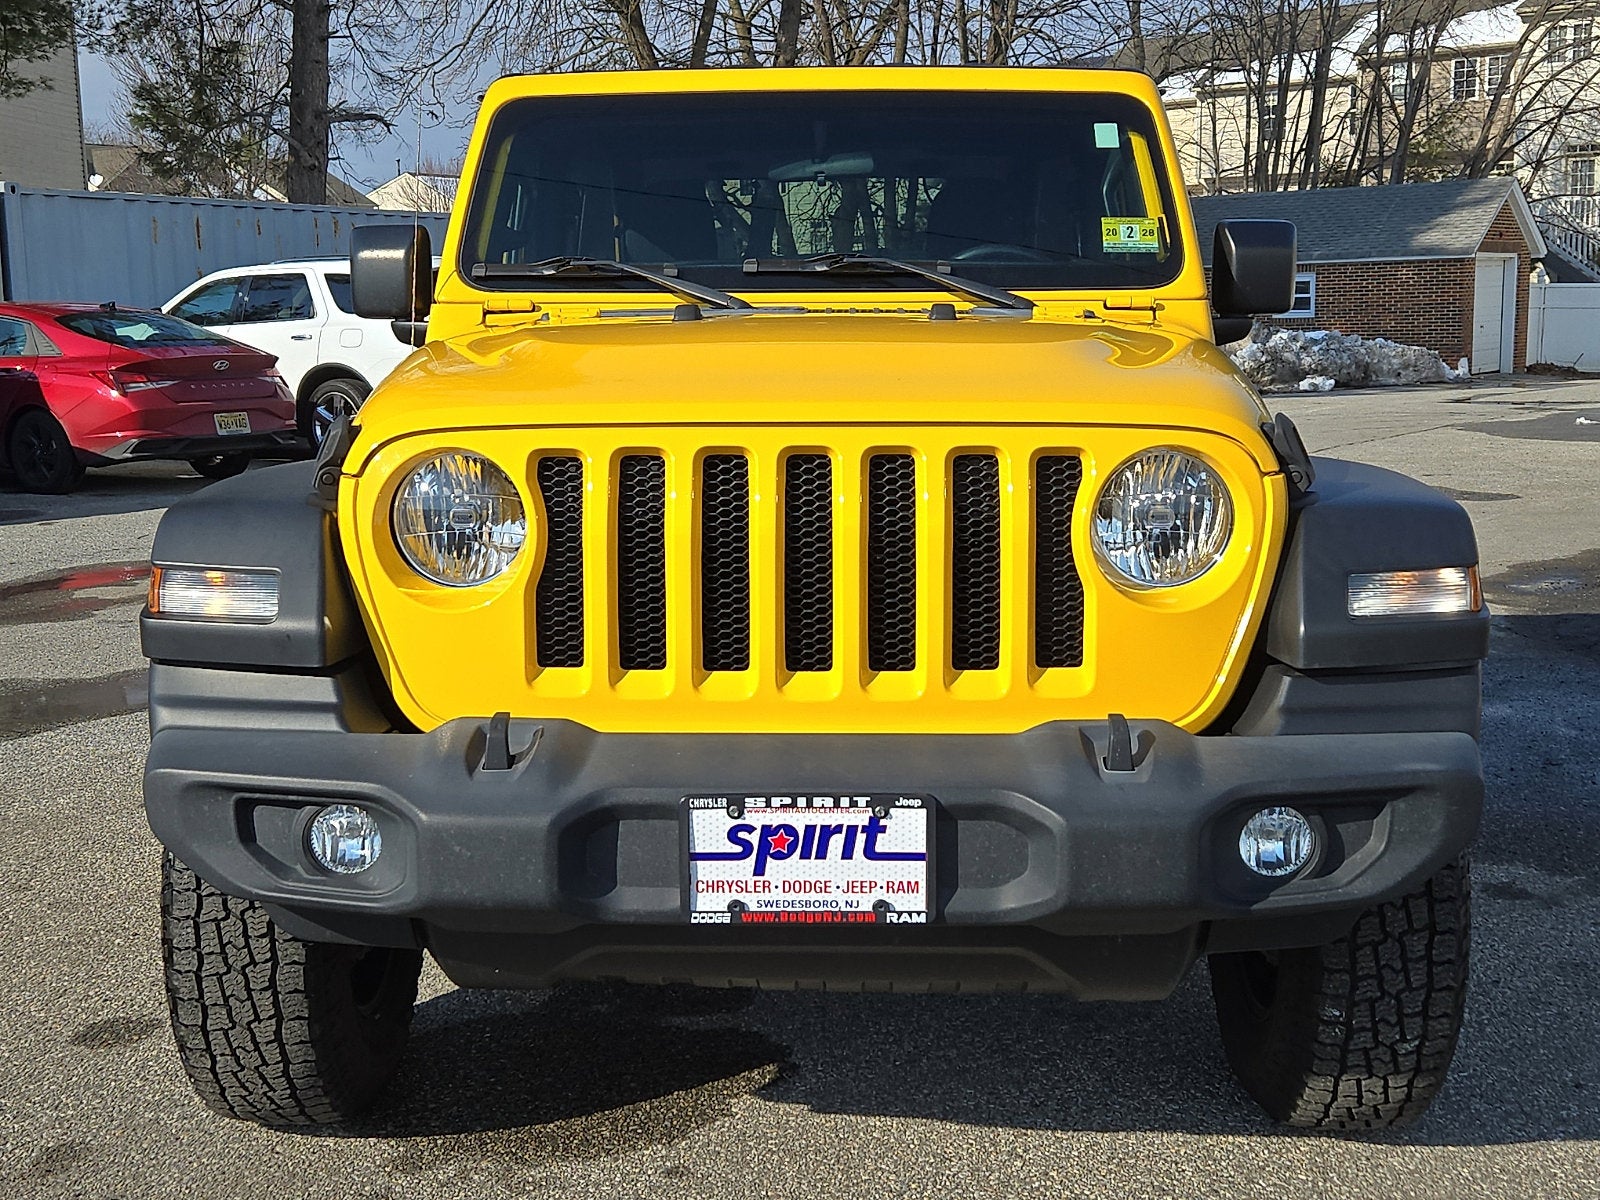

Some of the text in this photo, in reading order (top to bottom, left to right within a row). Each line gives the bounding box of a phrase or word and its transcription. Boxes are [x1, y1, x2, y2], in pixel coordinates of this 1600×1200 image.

[1105, 225, 1154, 238] 20 2 28
[689, 798, 728, 808] CHRYSLER
[744, 797, 871, 808] SPIRIT
[895, 797, 922, 807] Jeep
[690, 816, 927, 877] spirit
[695, 880, 919, 894] CHRYSLER DODGE JEEP RAM
[756, 900, 860, 910] SWEDESBORO, NJ
[690, 913, 731, 924] DODGE
[886, 913, 927, 924] RAM
